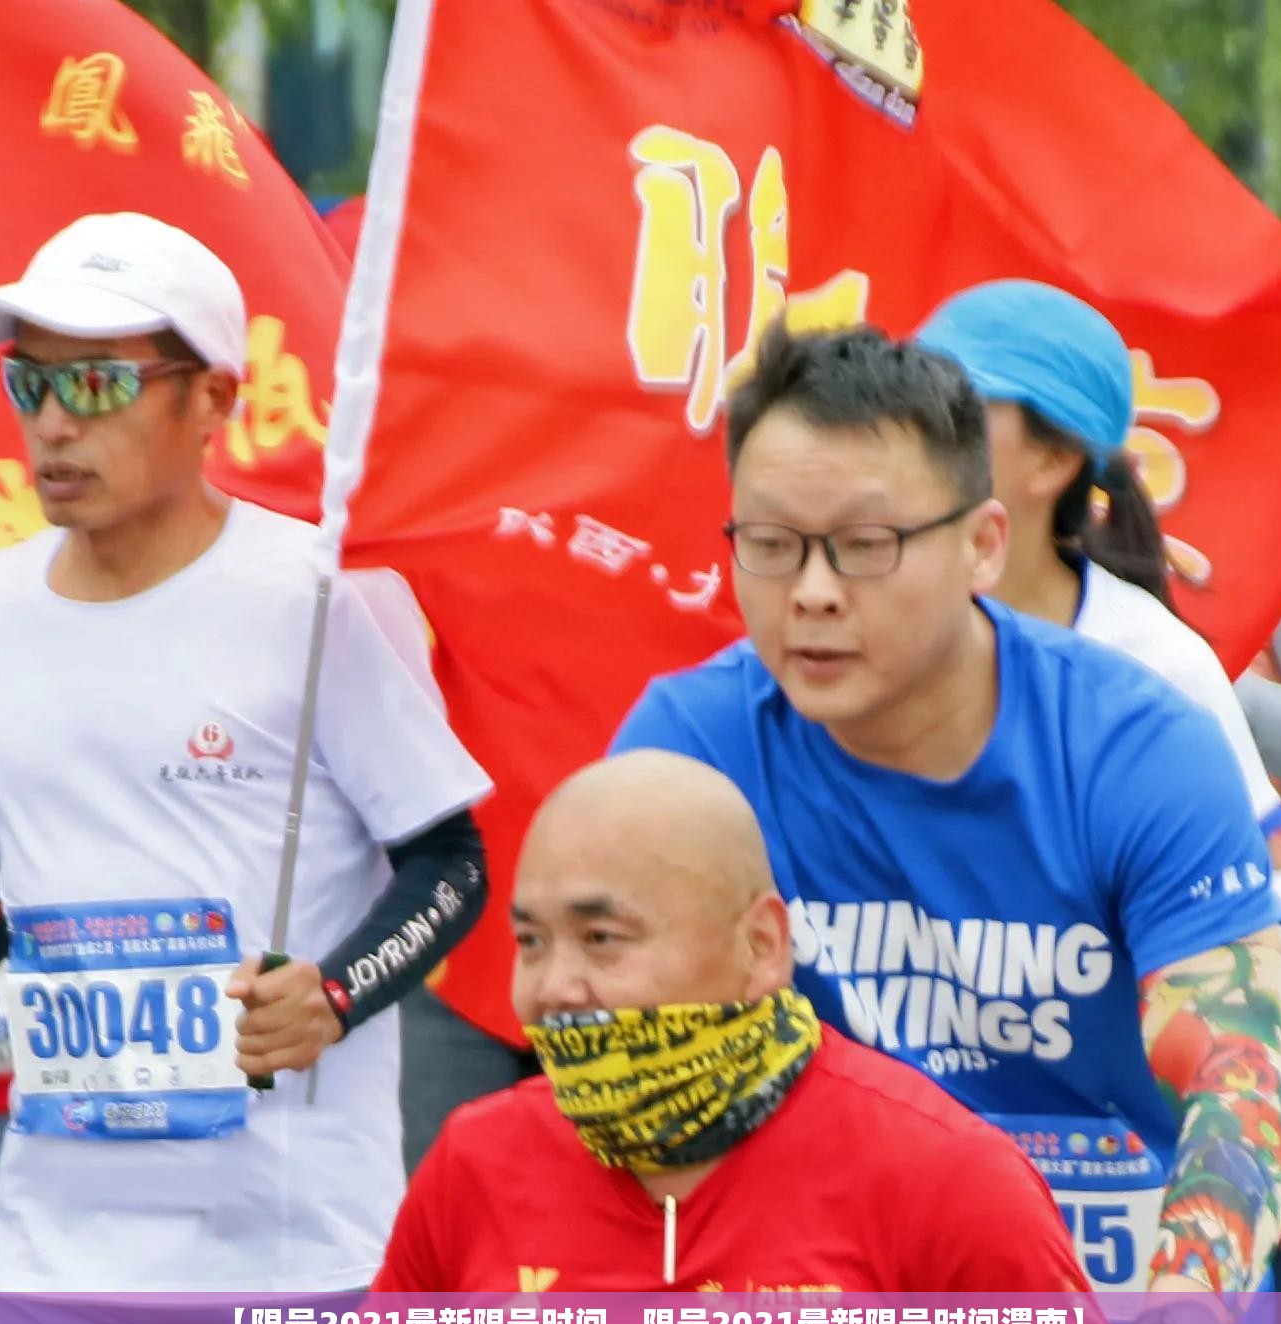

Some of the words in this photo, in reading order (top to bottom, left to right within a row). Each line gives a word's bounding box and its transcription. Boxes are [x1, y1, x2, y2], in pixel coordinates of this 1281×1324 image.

[346, 911, 438, 999] JOYRUN
[788, 896, 1114, 997] SHINNING
[21, 974, 222, 1060] 30048
[840, 976, 1075, 1062] WINGS
